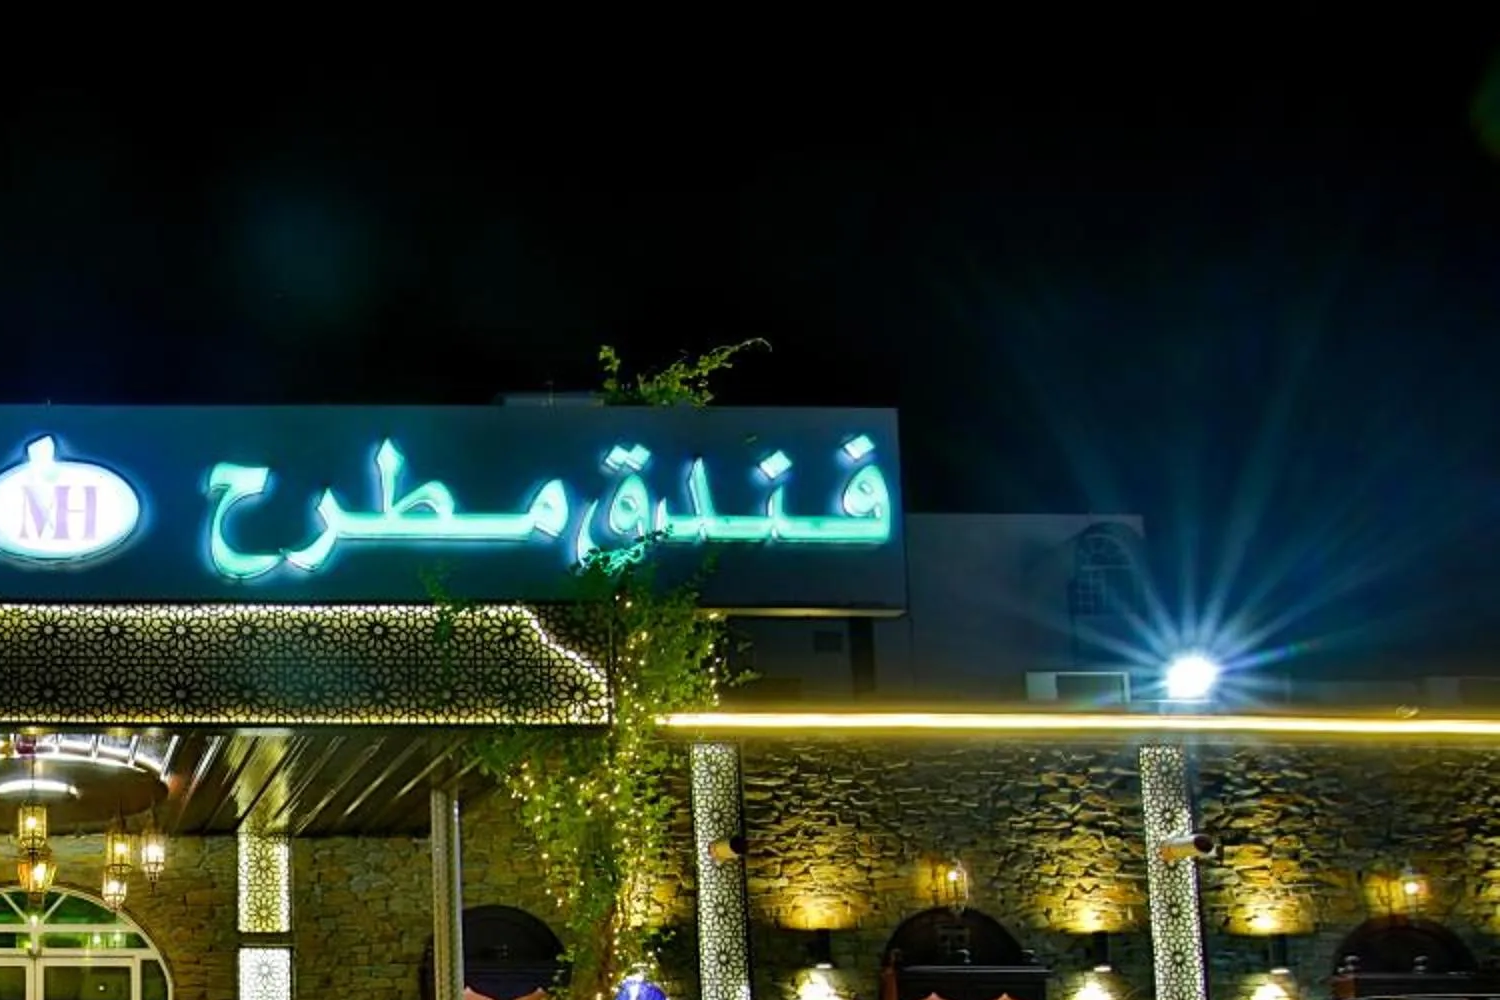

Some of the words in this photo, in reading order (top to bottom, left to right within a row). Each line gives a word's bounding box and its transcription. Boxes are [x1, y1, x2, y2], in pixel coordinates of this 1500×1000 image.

[19, 485, 97, 540] MH
[209, 438, 568, 581] مطرح
[576, 435, 891, 575] فندق
